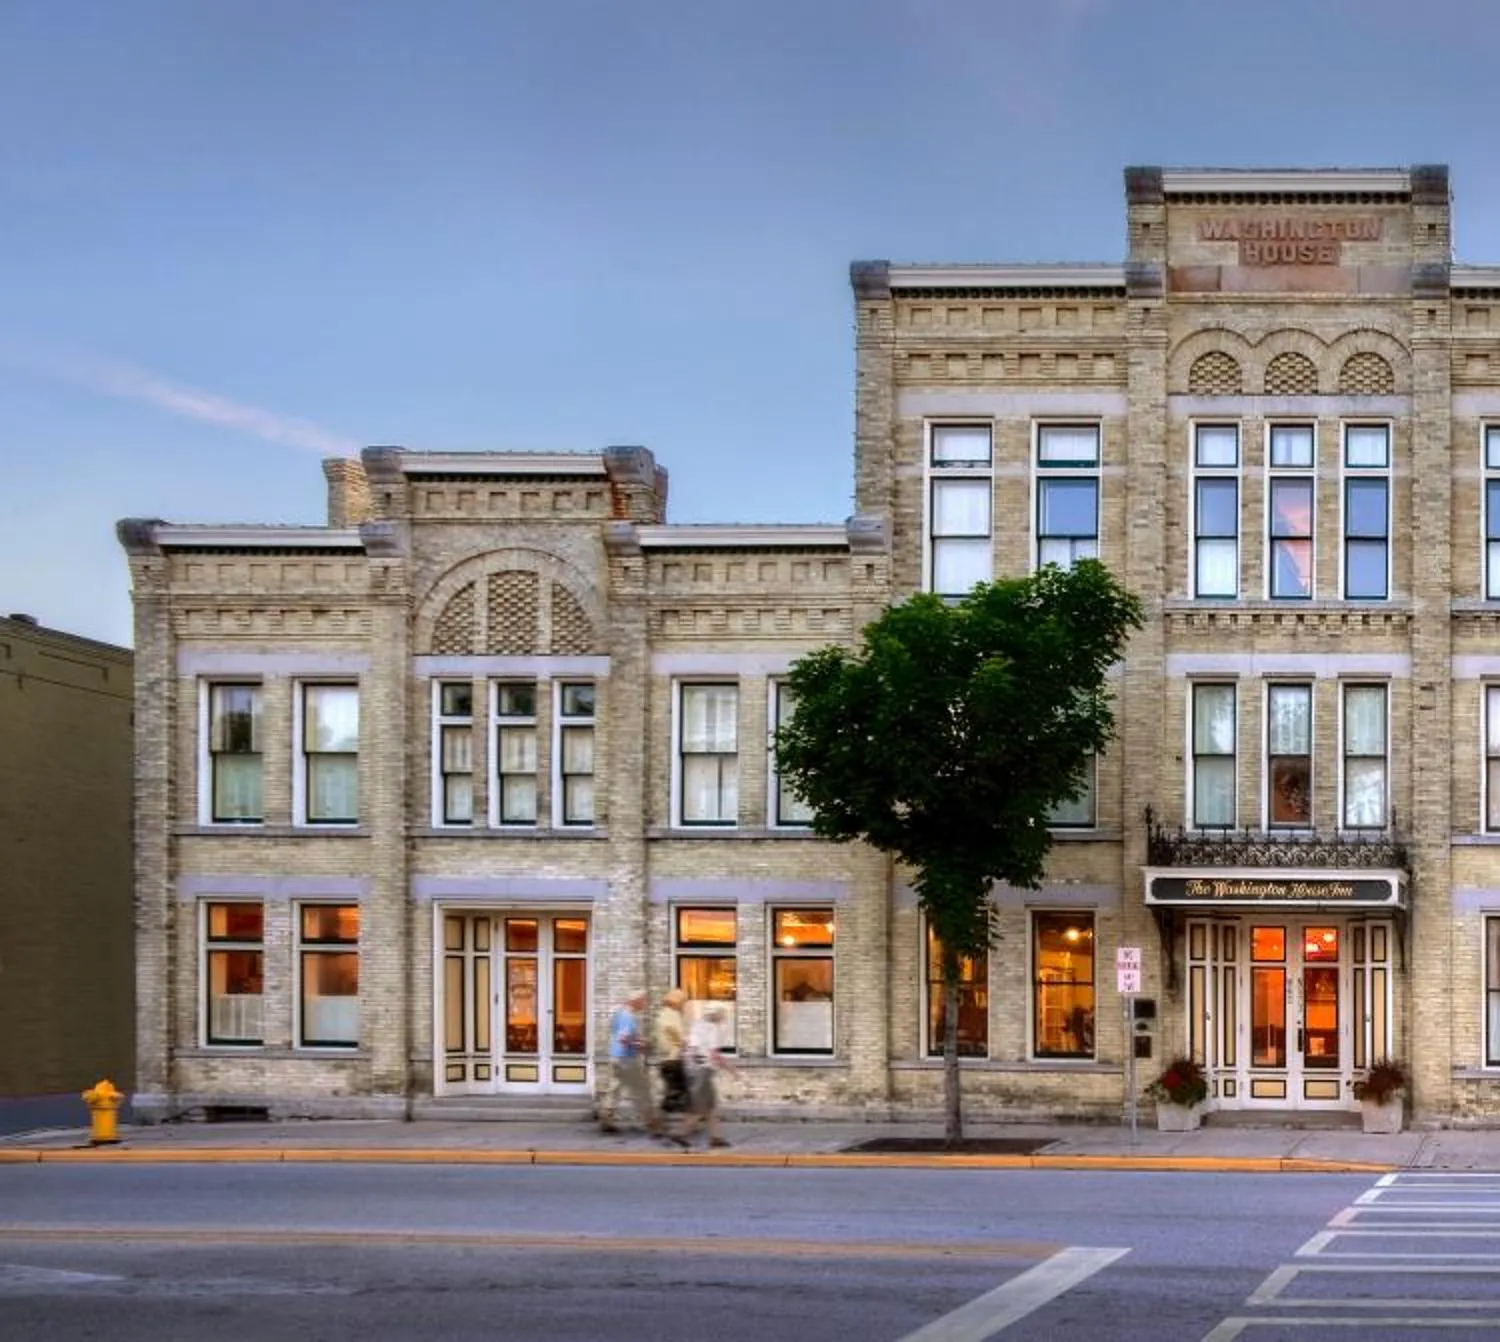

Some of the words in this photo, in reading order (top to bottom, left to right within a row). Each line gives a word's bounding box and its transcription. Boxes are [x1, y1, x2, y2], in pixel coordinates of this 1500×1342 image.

[1199, 217, 1382, 241] WASHINGTON
[1242, 241, 1335, 265] HOUSE
[1186, 880, 1211, 897] The
[1213, 880, 1286, 899] Washington
[1287, 881, 1329, 899] House
[1330, 881, 1354, 897] Inn
